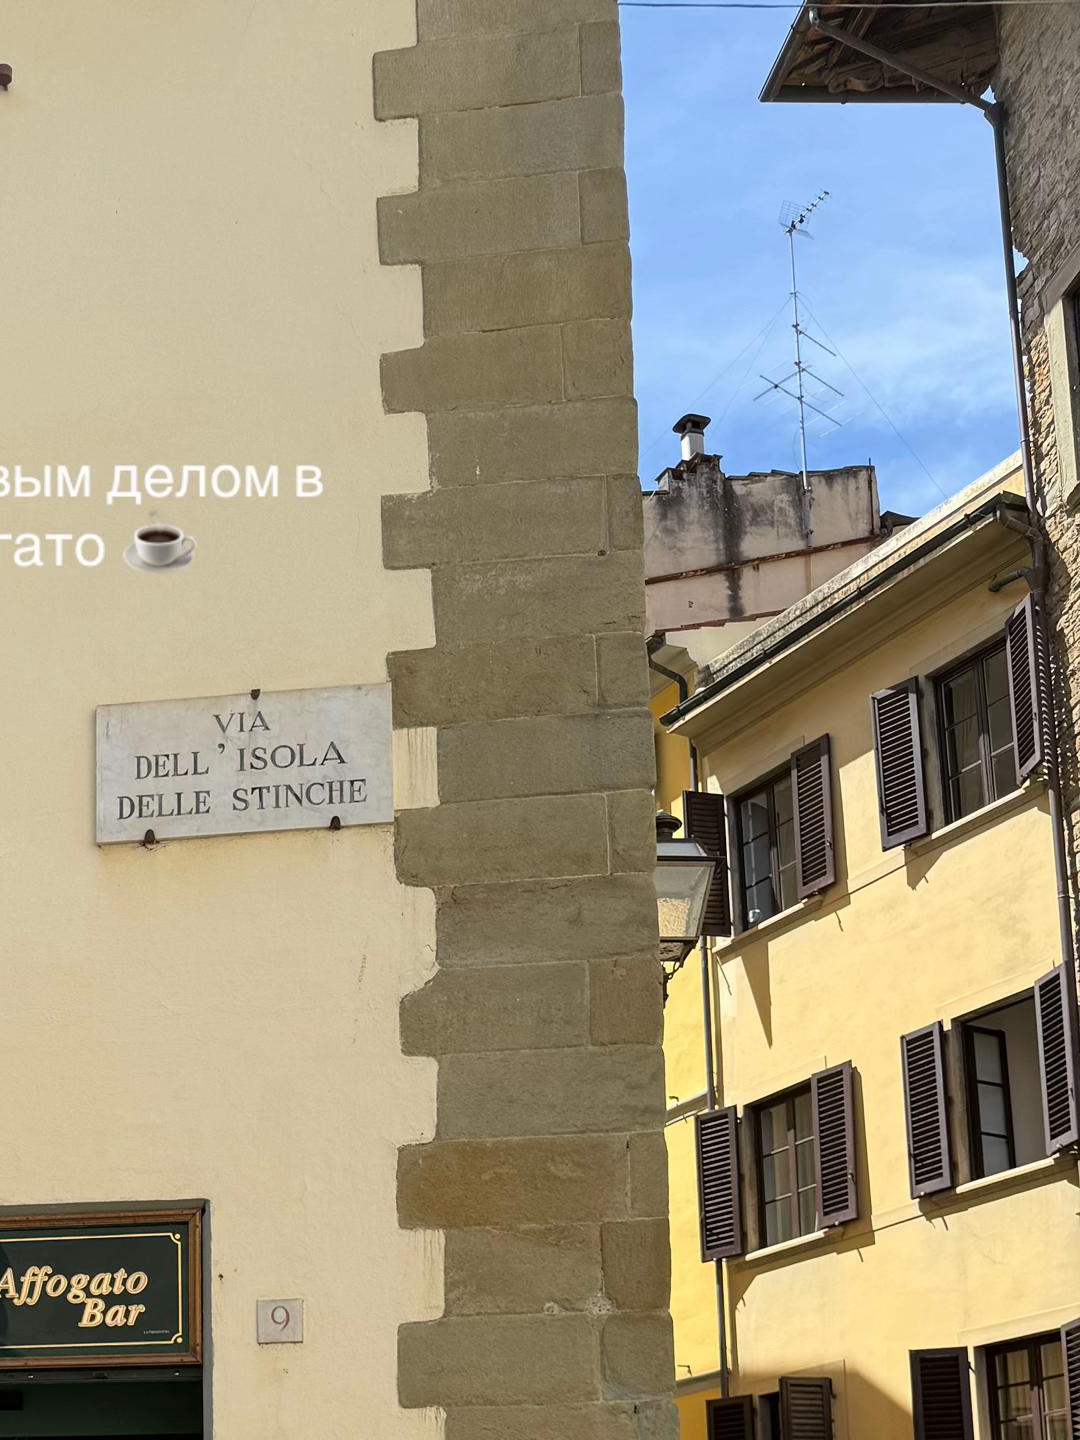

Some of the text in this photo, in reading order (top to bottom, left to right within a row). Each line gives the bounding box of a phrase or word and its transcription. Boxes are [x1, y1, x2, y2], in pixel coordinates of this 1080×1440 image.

[212, 711, 271, 734] VIA
[116, 778, 368, 820] DELLE STINCHE
[77, 1297, 146, 1328] Bar
[270, 1305, 290, 1332] 9
